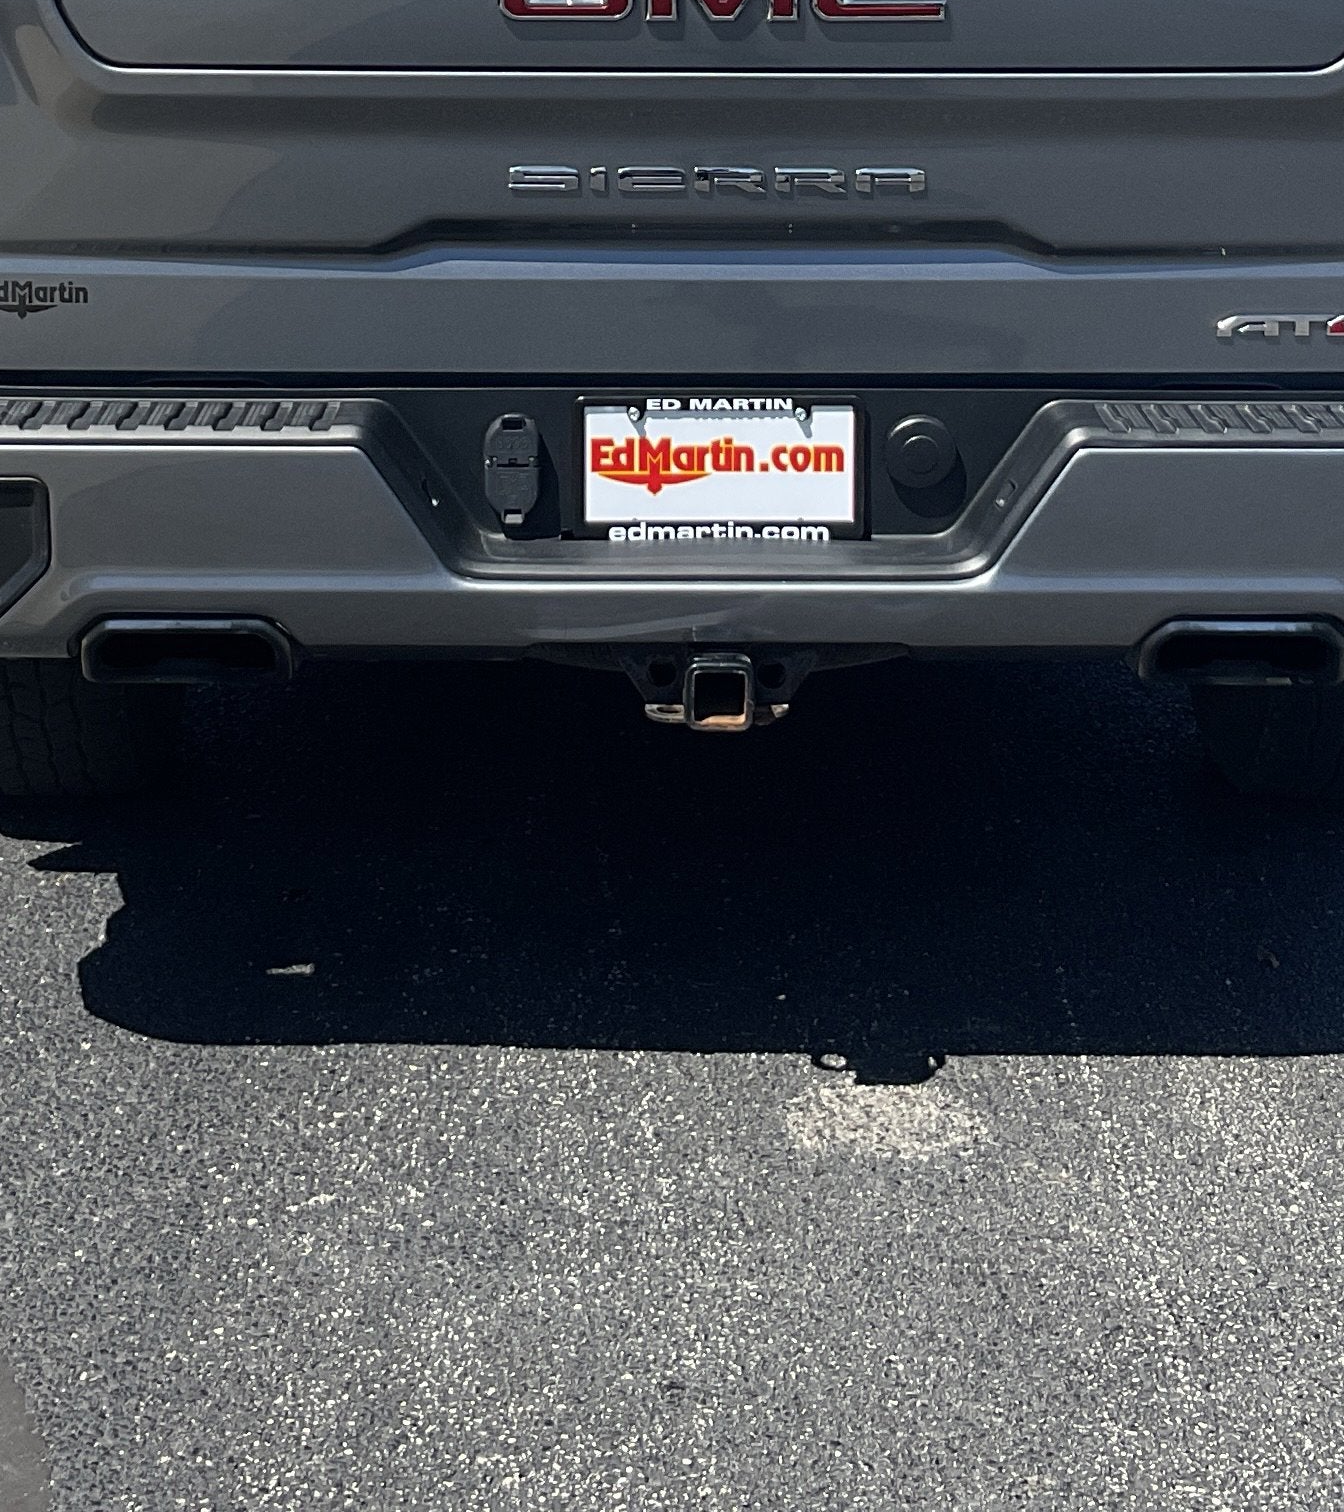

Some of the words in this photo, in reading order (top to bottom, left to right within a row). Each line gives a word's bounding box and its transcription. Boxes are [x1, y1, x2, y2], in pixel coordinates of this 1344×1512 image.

[508, 164, 929, 194] SIERRA
[646, 398, 682, 411] ED
[689, 398, 793, 411] MARTIN
[590, 435, 845, 478] EdMartin.com
[609, 521, 831, 542] edmartin.com
